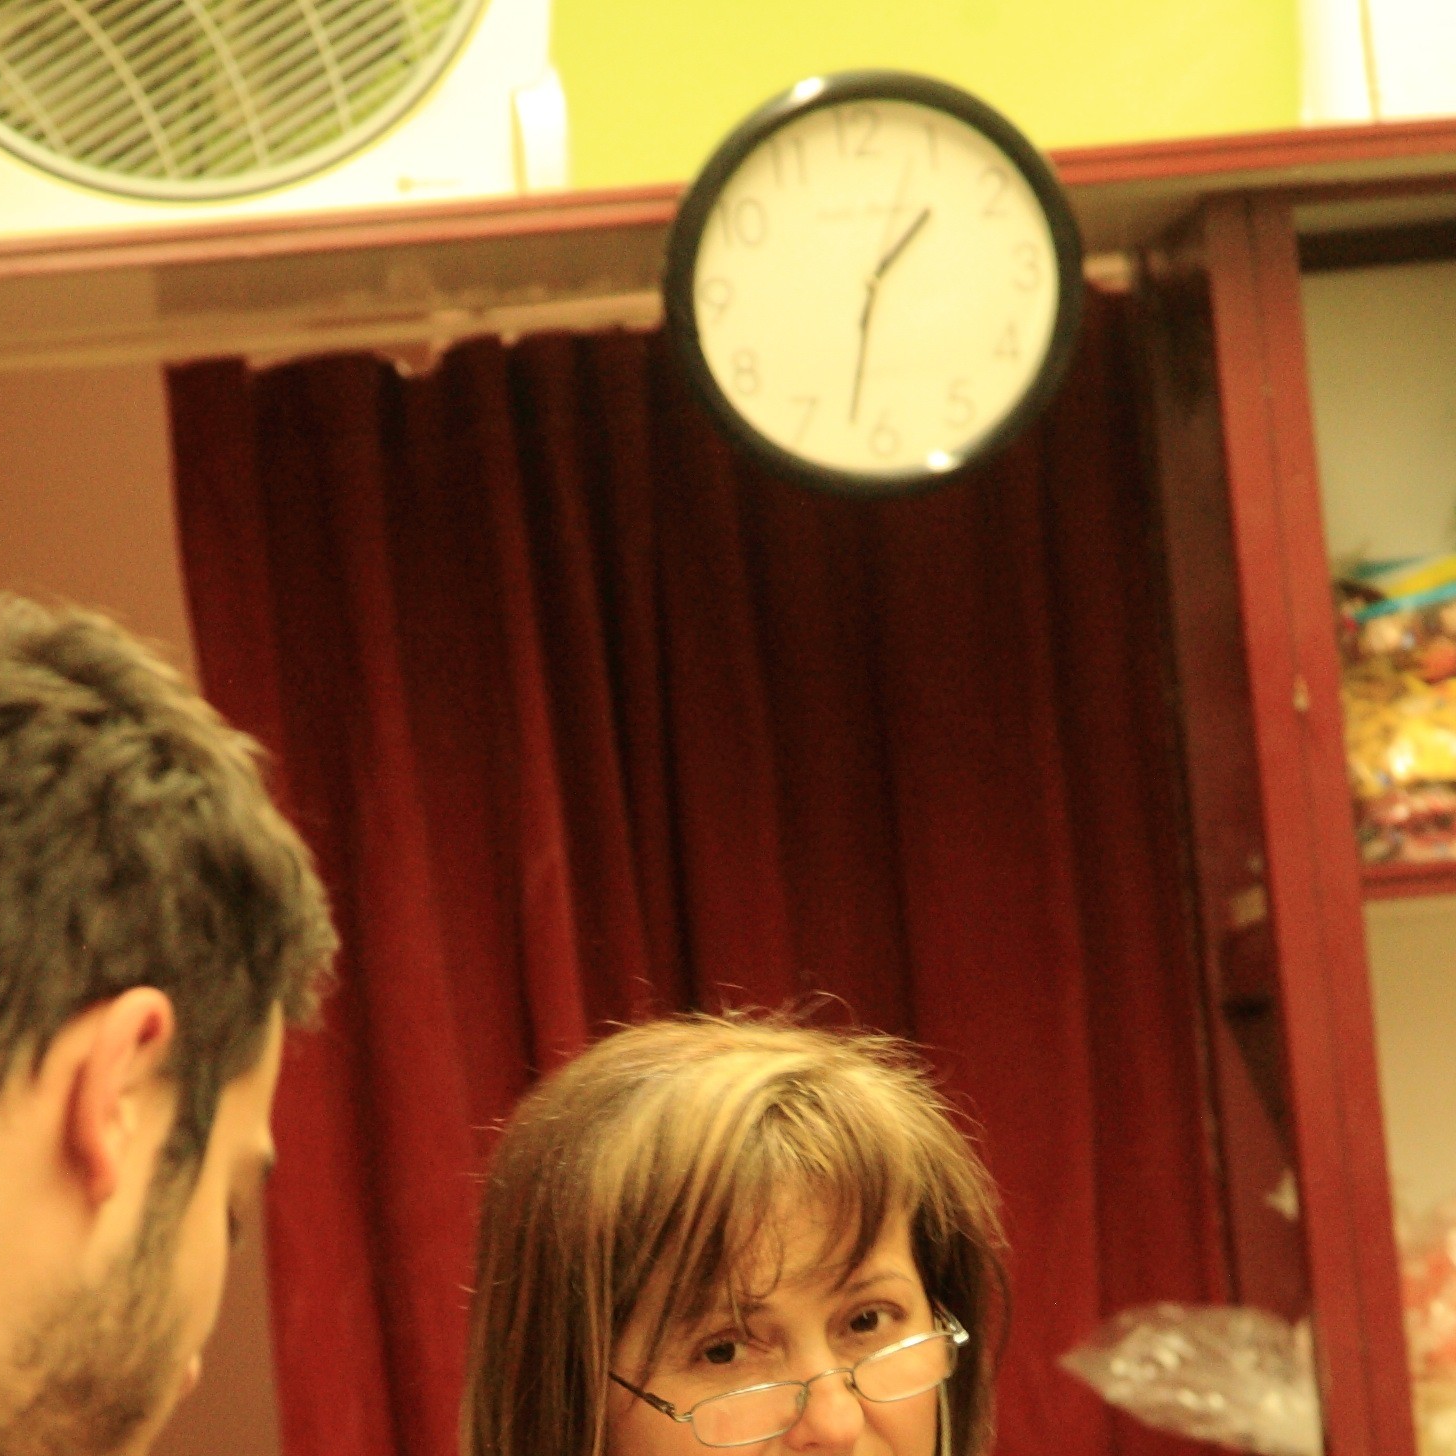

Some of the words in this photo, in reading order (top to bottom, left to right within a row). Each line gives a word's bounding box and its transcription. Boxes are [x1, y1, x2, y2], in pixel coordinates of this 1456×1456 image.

[978, 167, 1012, 219] 2
[1012, 240, 1042, 293] 3
[701, 276, 734, 328] 9
[867, 409, 902, 461] 6
